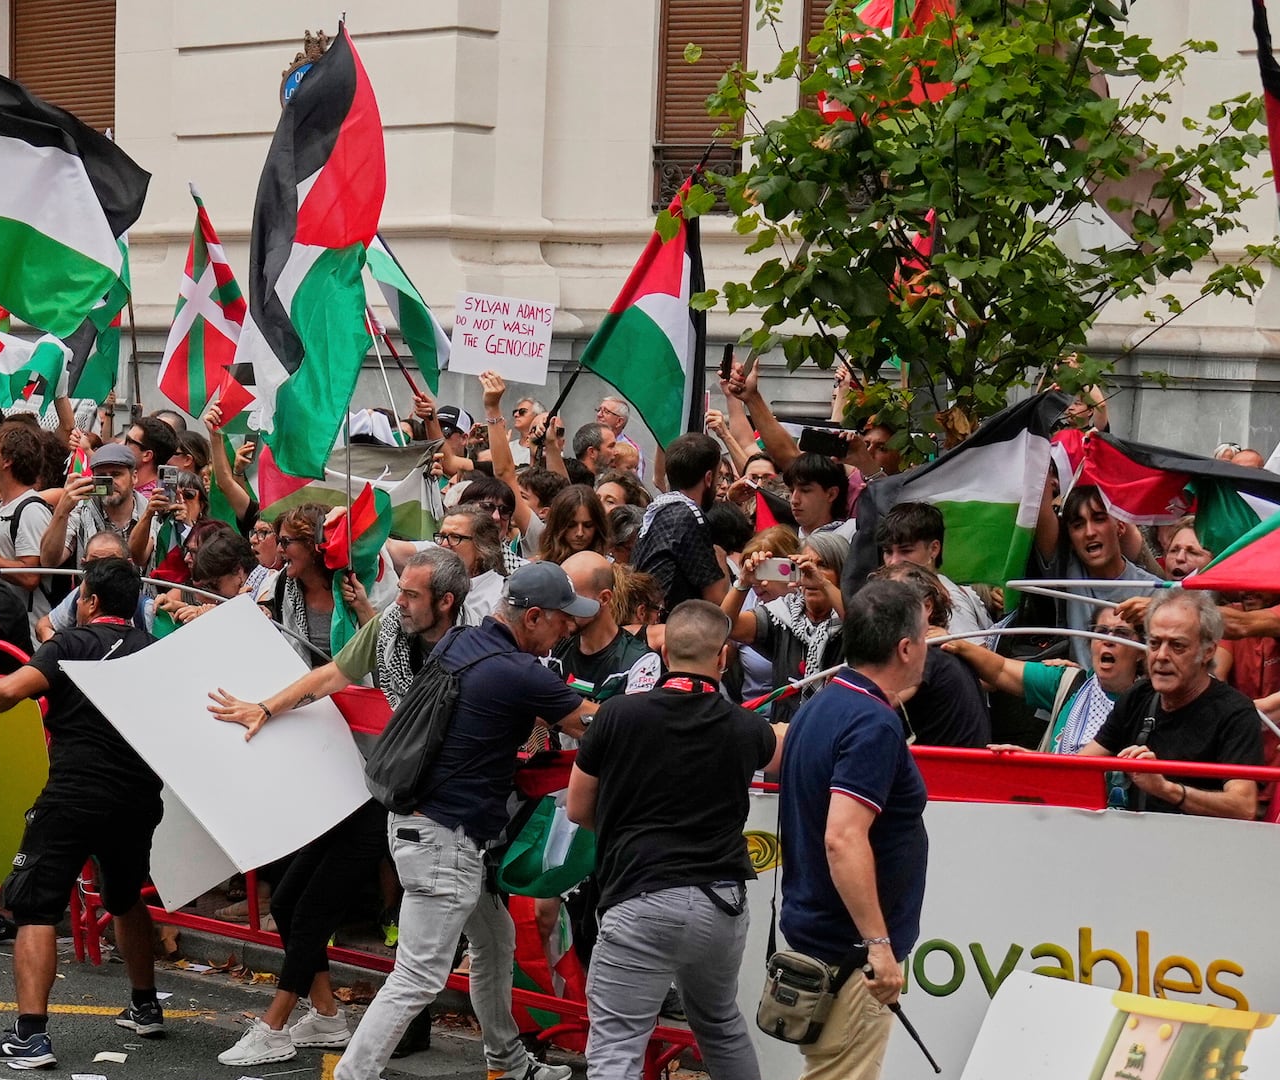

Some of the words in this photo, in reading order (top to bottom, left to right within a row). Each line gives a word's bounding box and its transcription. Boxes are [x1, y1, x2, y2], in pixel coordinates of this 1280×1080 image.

[464, 297, 511, 316] SYLVAN
[455, 315, 467, 326] DO
[473, 318, 496, 331] NOT
[503, 320, 535, 336] WASH
[463, 333, 479, 347] THE
[485, 334, 545, 358] GENOCIDE
